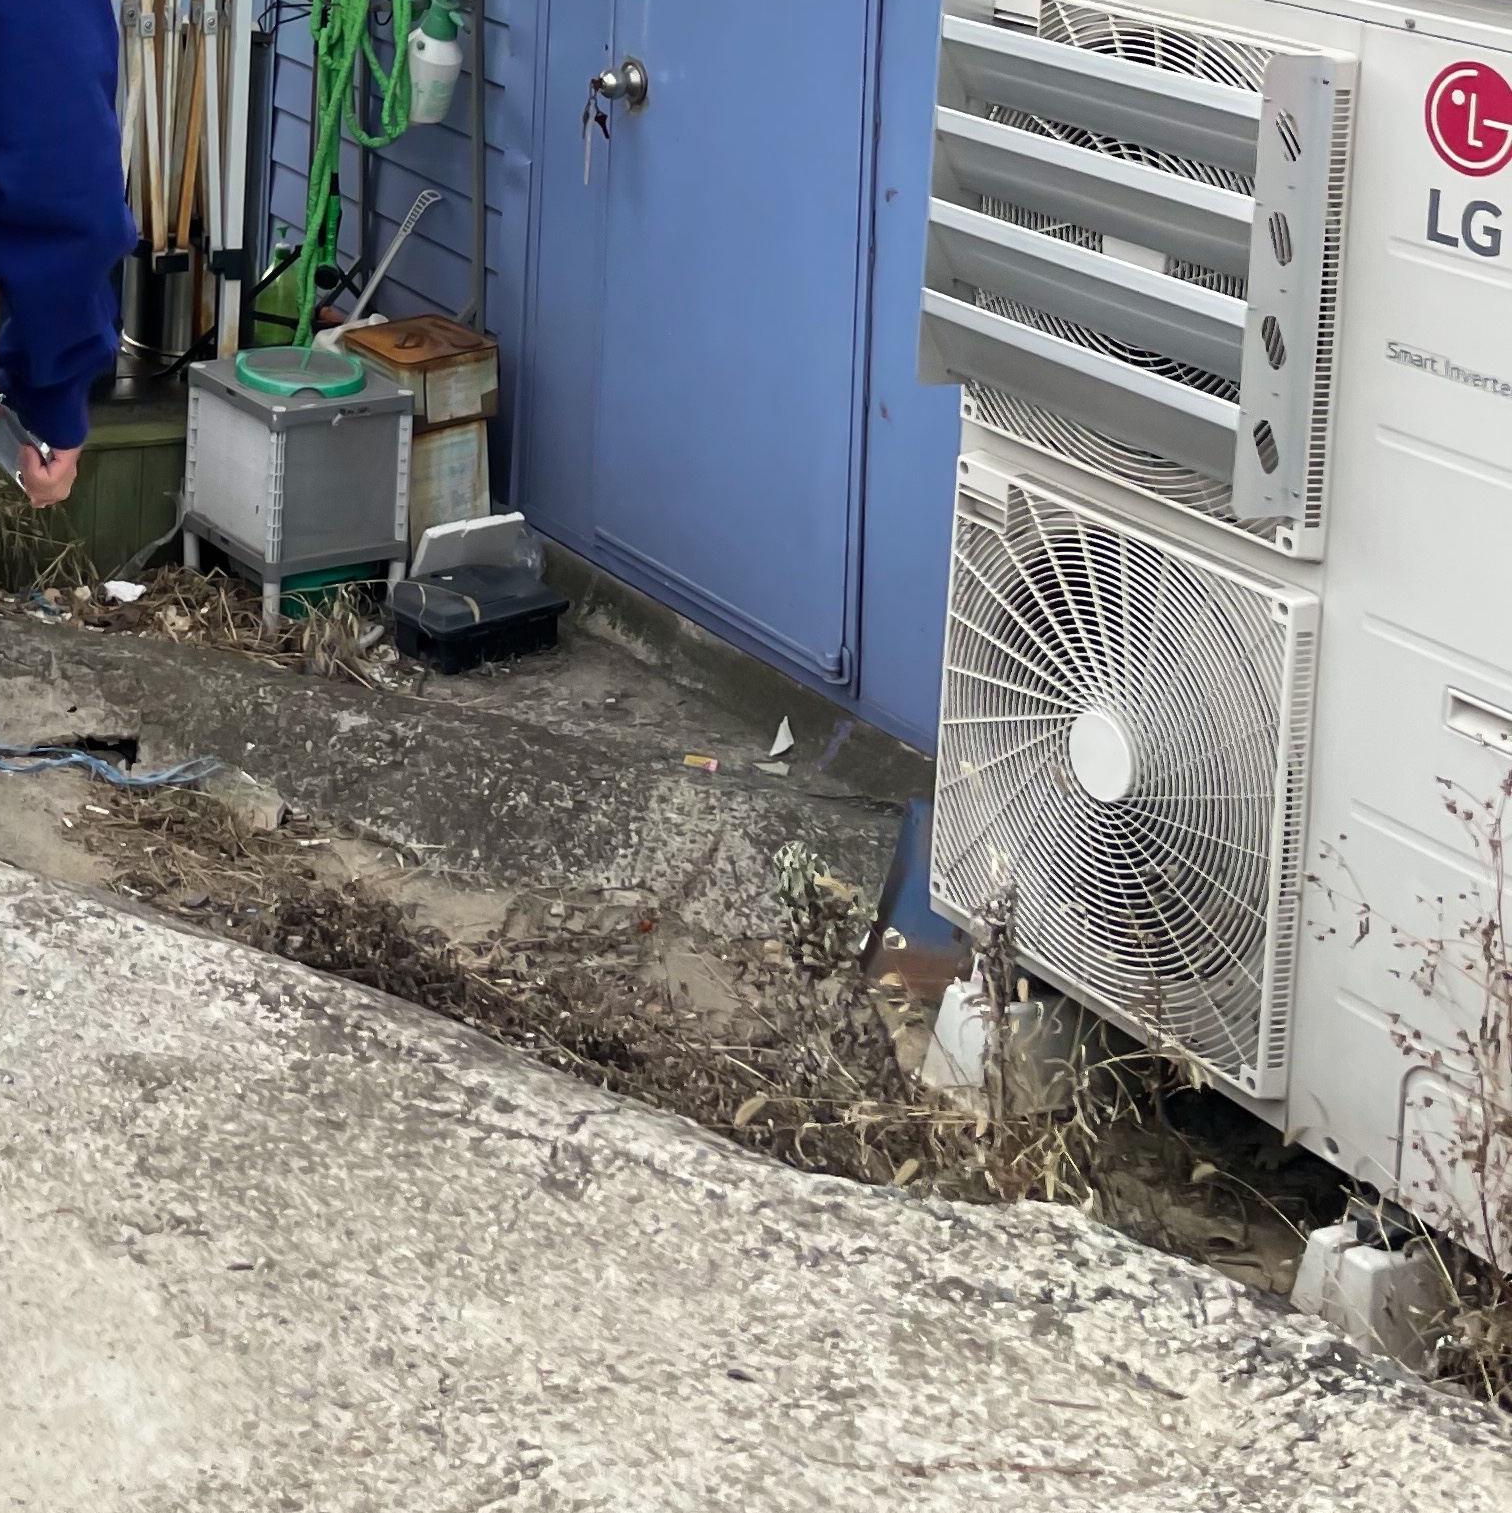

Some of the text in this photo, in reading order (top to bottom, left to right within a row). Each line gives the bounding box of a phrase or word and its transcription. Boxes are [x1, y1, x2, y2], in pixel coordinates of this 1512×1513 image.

[1426, 188, 1503, 258] LG
[1387, 341, 1512, 397] Smart Inverte
